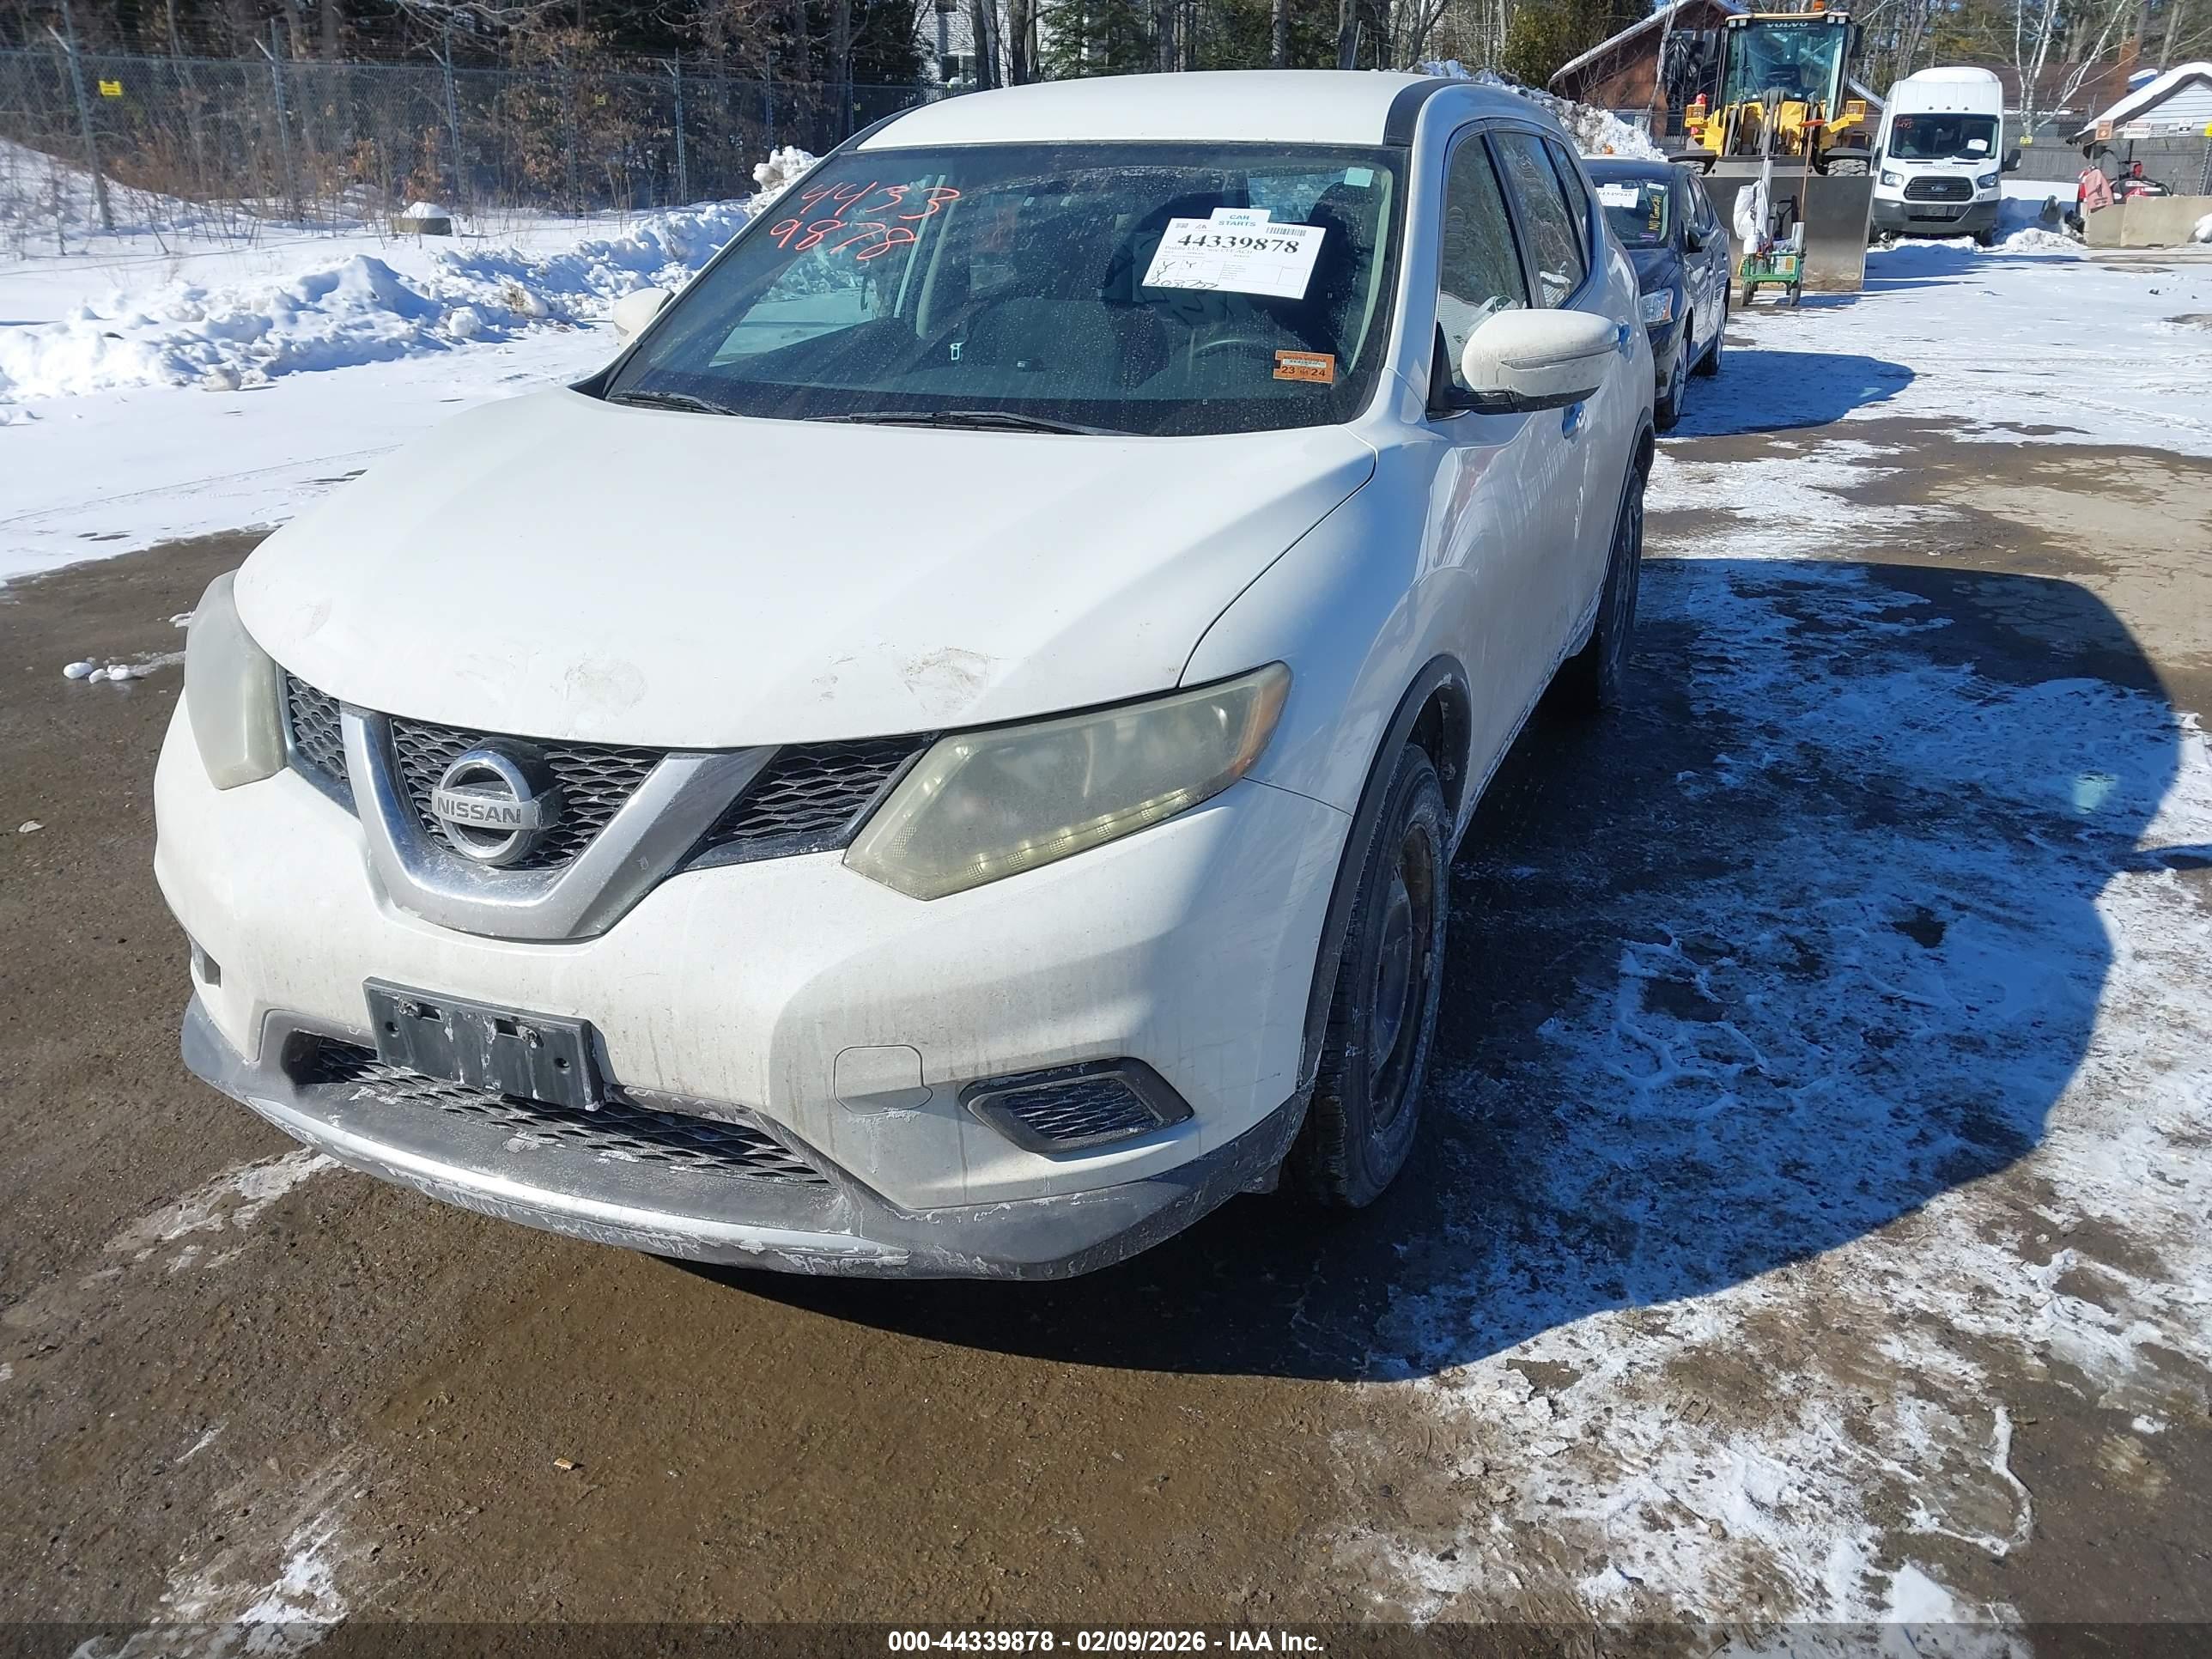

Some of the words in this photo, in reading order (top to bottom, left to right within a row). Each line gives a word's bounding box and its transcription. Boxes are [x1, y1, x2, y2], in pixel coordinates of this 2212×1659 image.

[799, 181, 961, 220] 4433
[1177, 233, 1300, 254] 44339878
[1281, 366, 1295, 374] 23
[1311, 368, 1326, 377] 24
[436, 796, 521, 824] NISSAN
